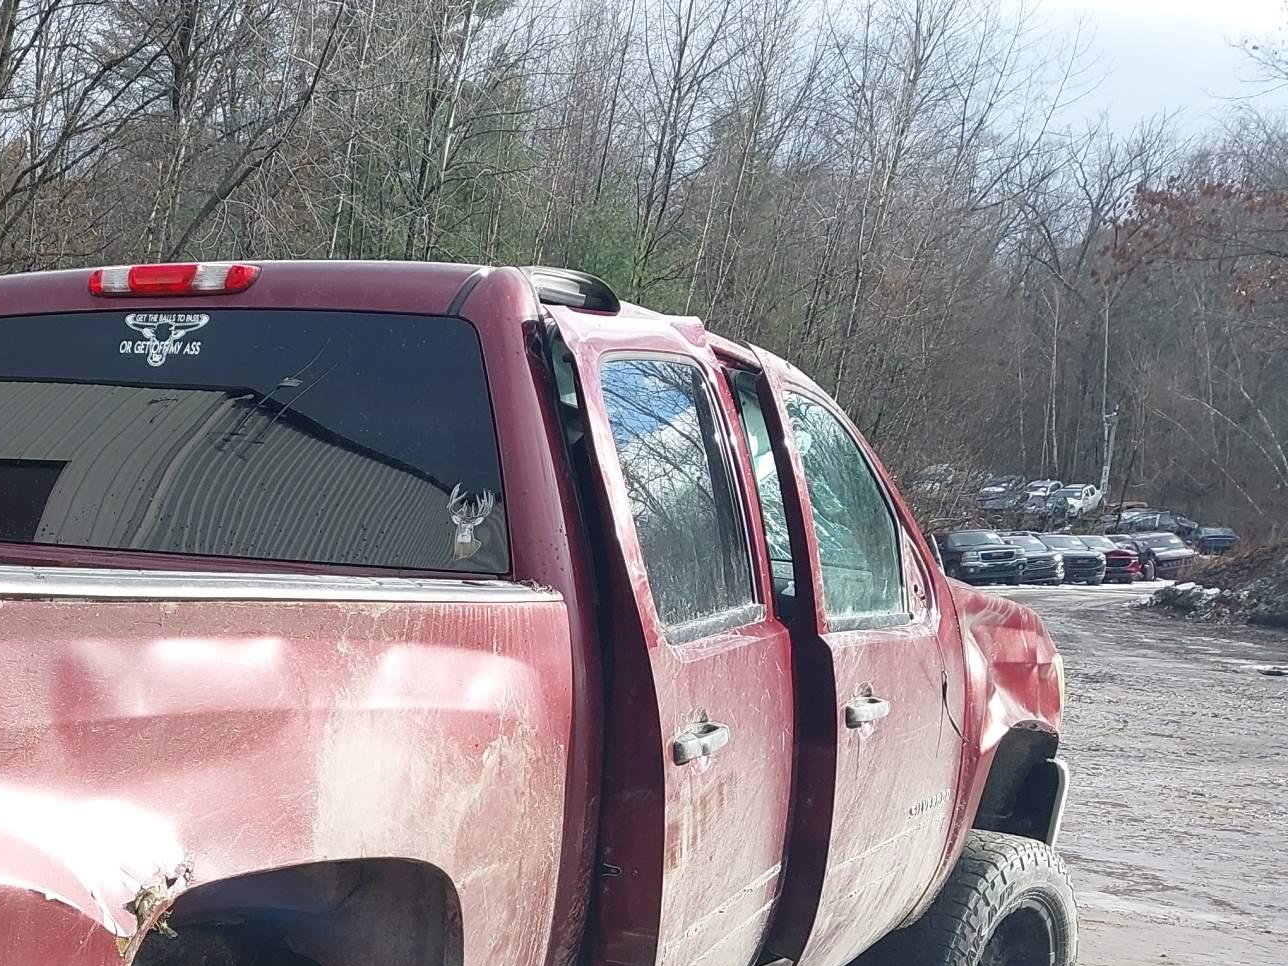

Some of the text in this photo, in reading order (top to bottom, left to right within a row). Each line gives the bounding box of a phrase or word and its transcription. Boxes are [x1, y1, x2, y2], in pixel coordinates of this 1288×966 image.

[136, 314, 200, 322] GET THE BALLS TO PASS
[119, 341, 202, 355] OR GET OFF MY ASS
